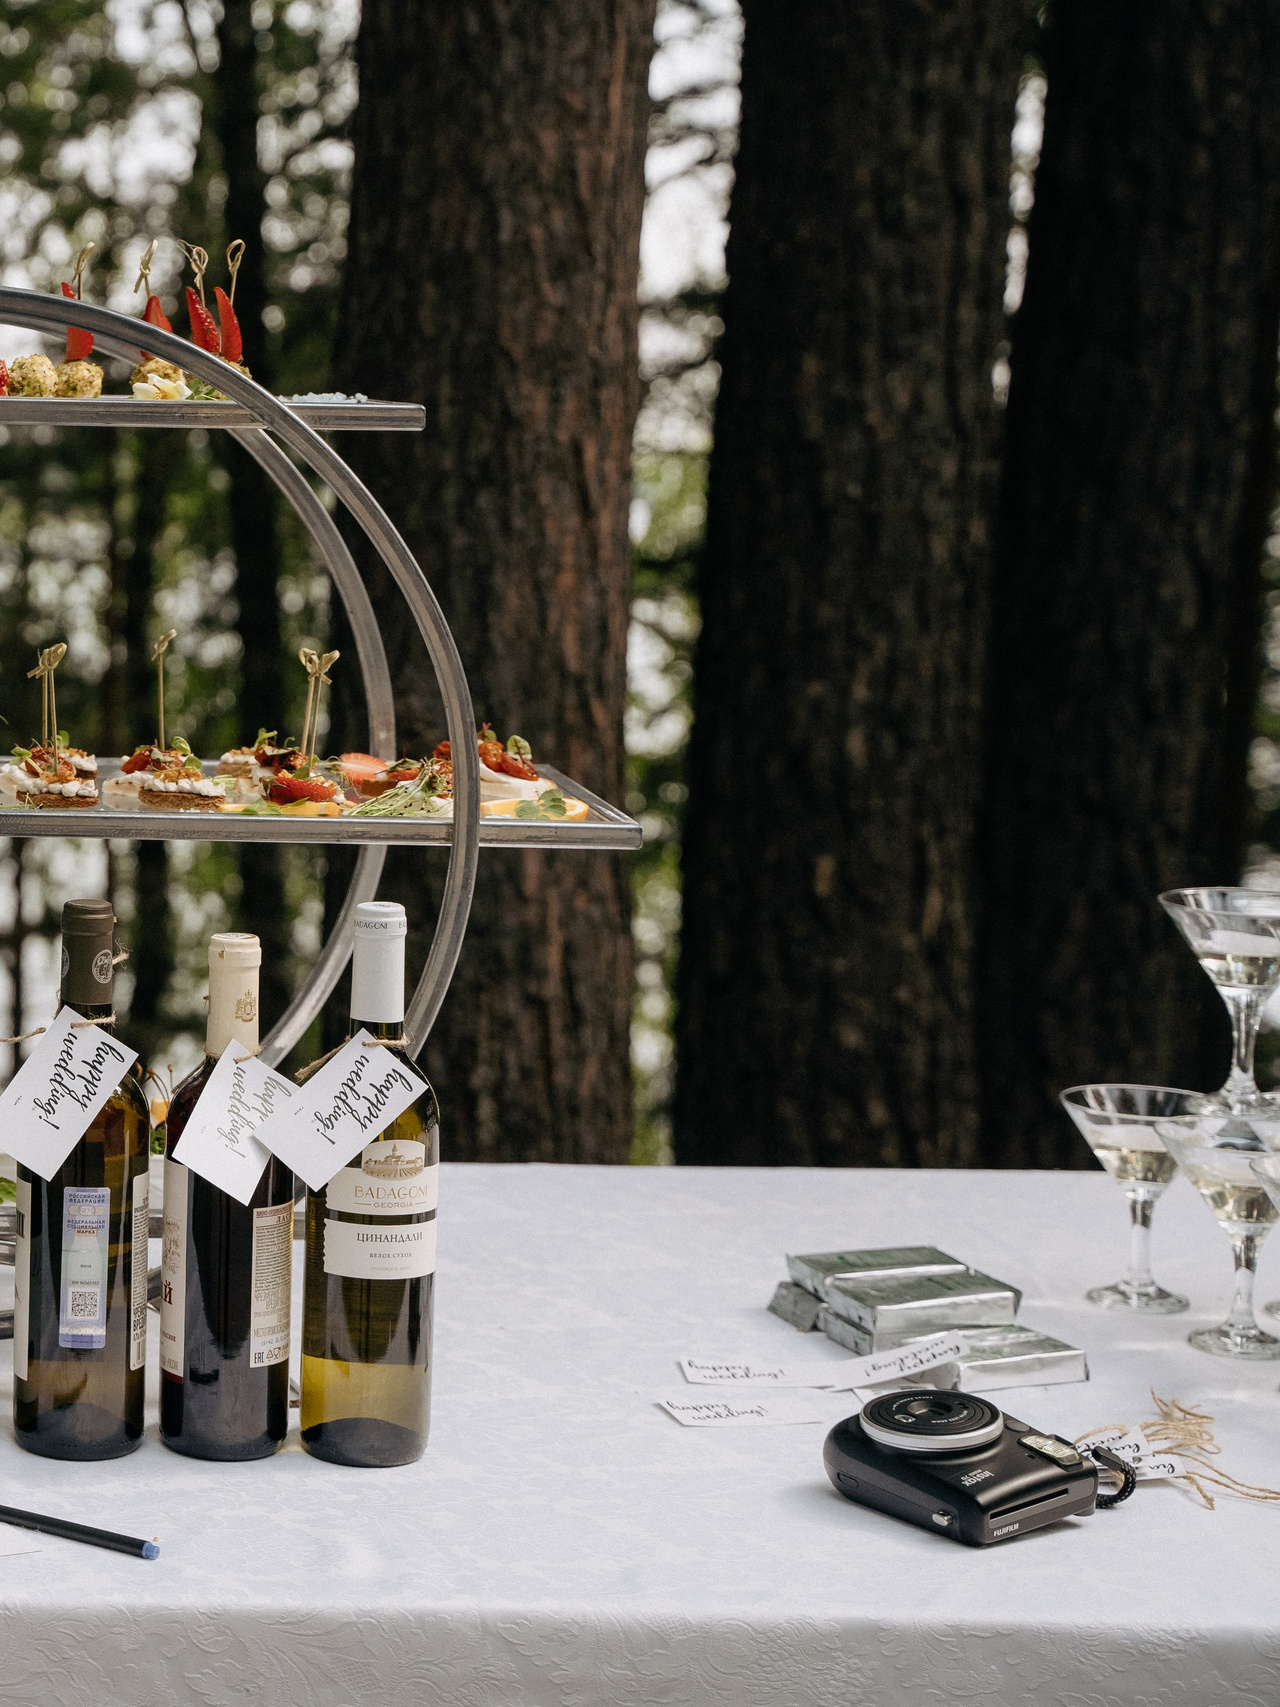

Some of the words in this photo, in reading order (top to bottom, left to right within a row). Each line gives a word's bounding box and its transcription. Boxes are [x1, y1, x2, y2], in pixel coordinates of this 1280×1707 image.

[33, 1032, 78, 1130] wedding!
[70, 1041, 125, 1112] happy
[314, 1054, 370, 1145] wedding!
[350, 1068, 413, 1133] happy
[217, 1066, 251, 1158] wedding!
[354, 1184, 428, 1200] BADAGONI
[373, 1201, 414, 1209] GEORGIA
[357, 1231, 424, 1243] ЦИНАНДАЛИ
[688, 1360, 750, 1375] happy
[666, 1400, 732, 1412] happy
[993, 1522, 1019, 1537] FUJIFILM
